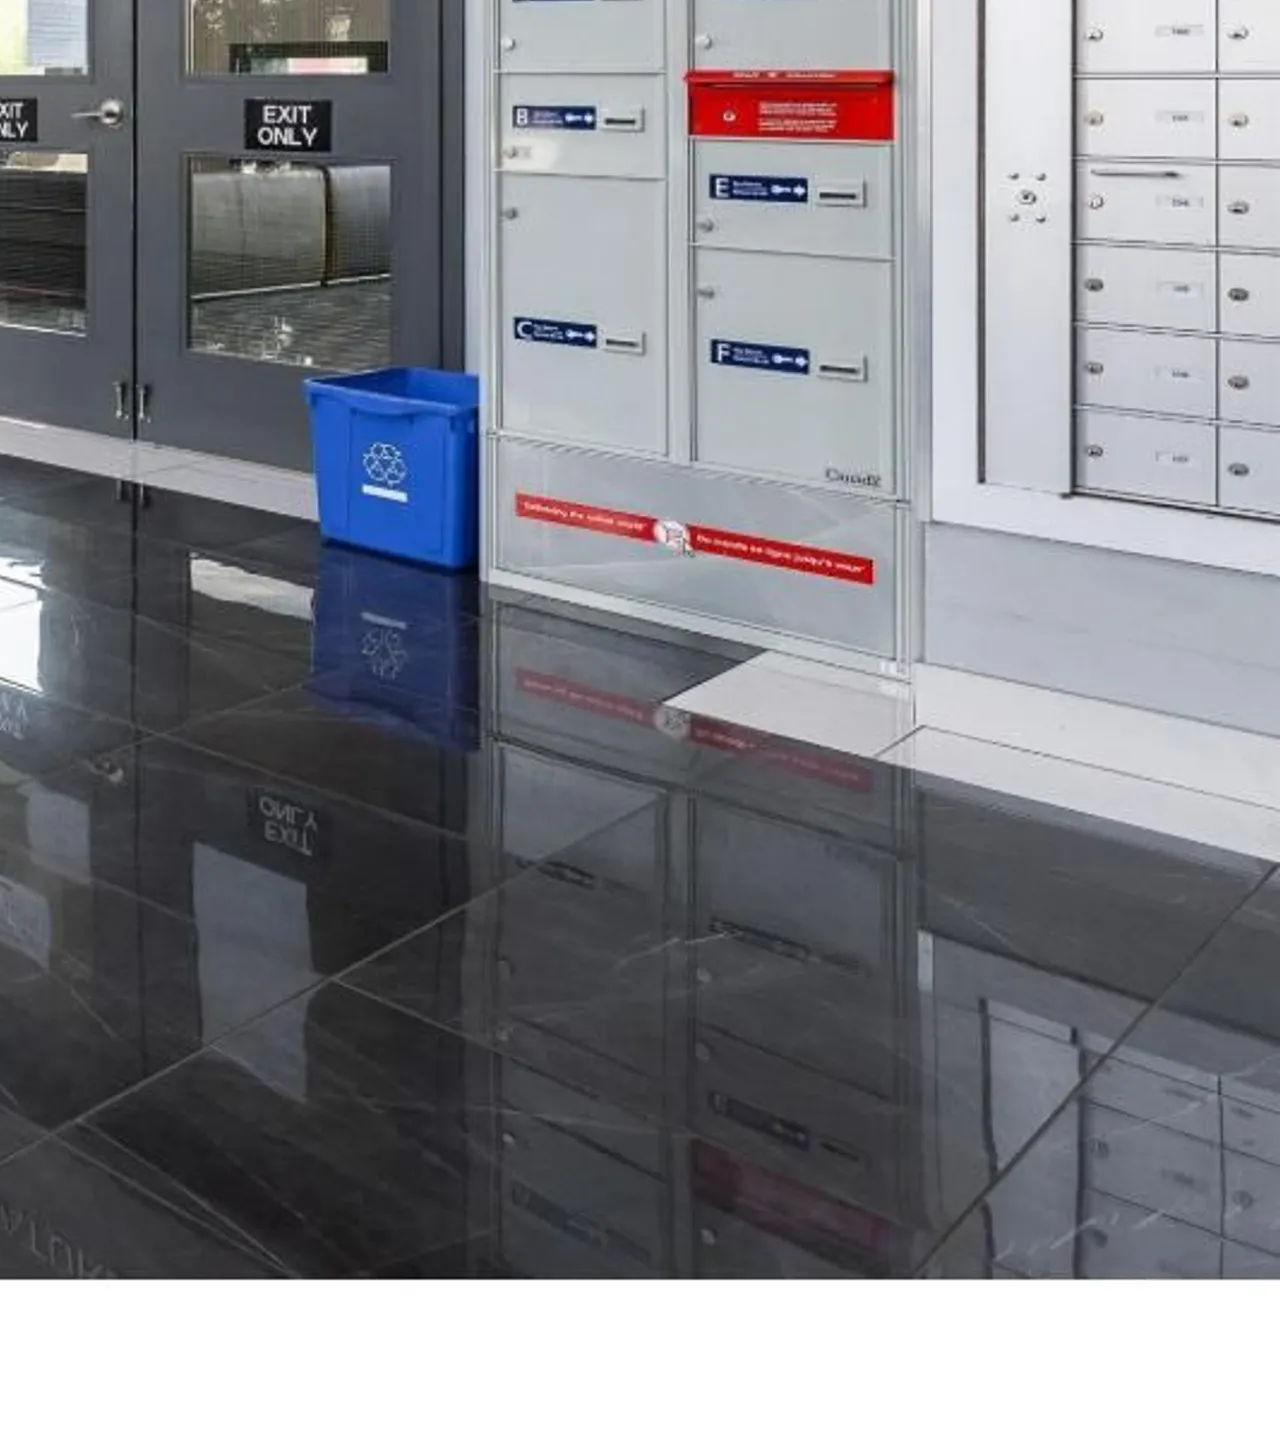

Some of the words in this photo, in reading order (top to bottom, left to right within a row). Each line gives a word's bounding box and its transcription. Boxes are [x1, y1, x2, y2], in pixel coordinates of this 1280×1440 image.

[262, 105, 312, 126] EXIT
[515, 108, 528, 127] B
[258, 126, 318, 148] ONLY
[716, 177, 729, 198] E
[516, 320, 533, 340] C
[717, 343, 730, 363] F
